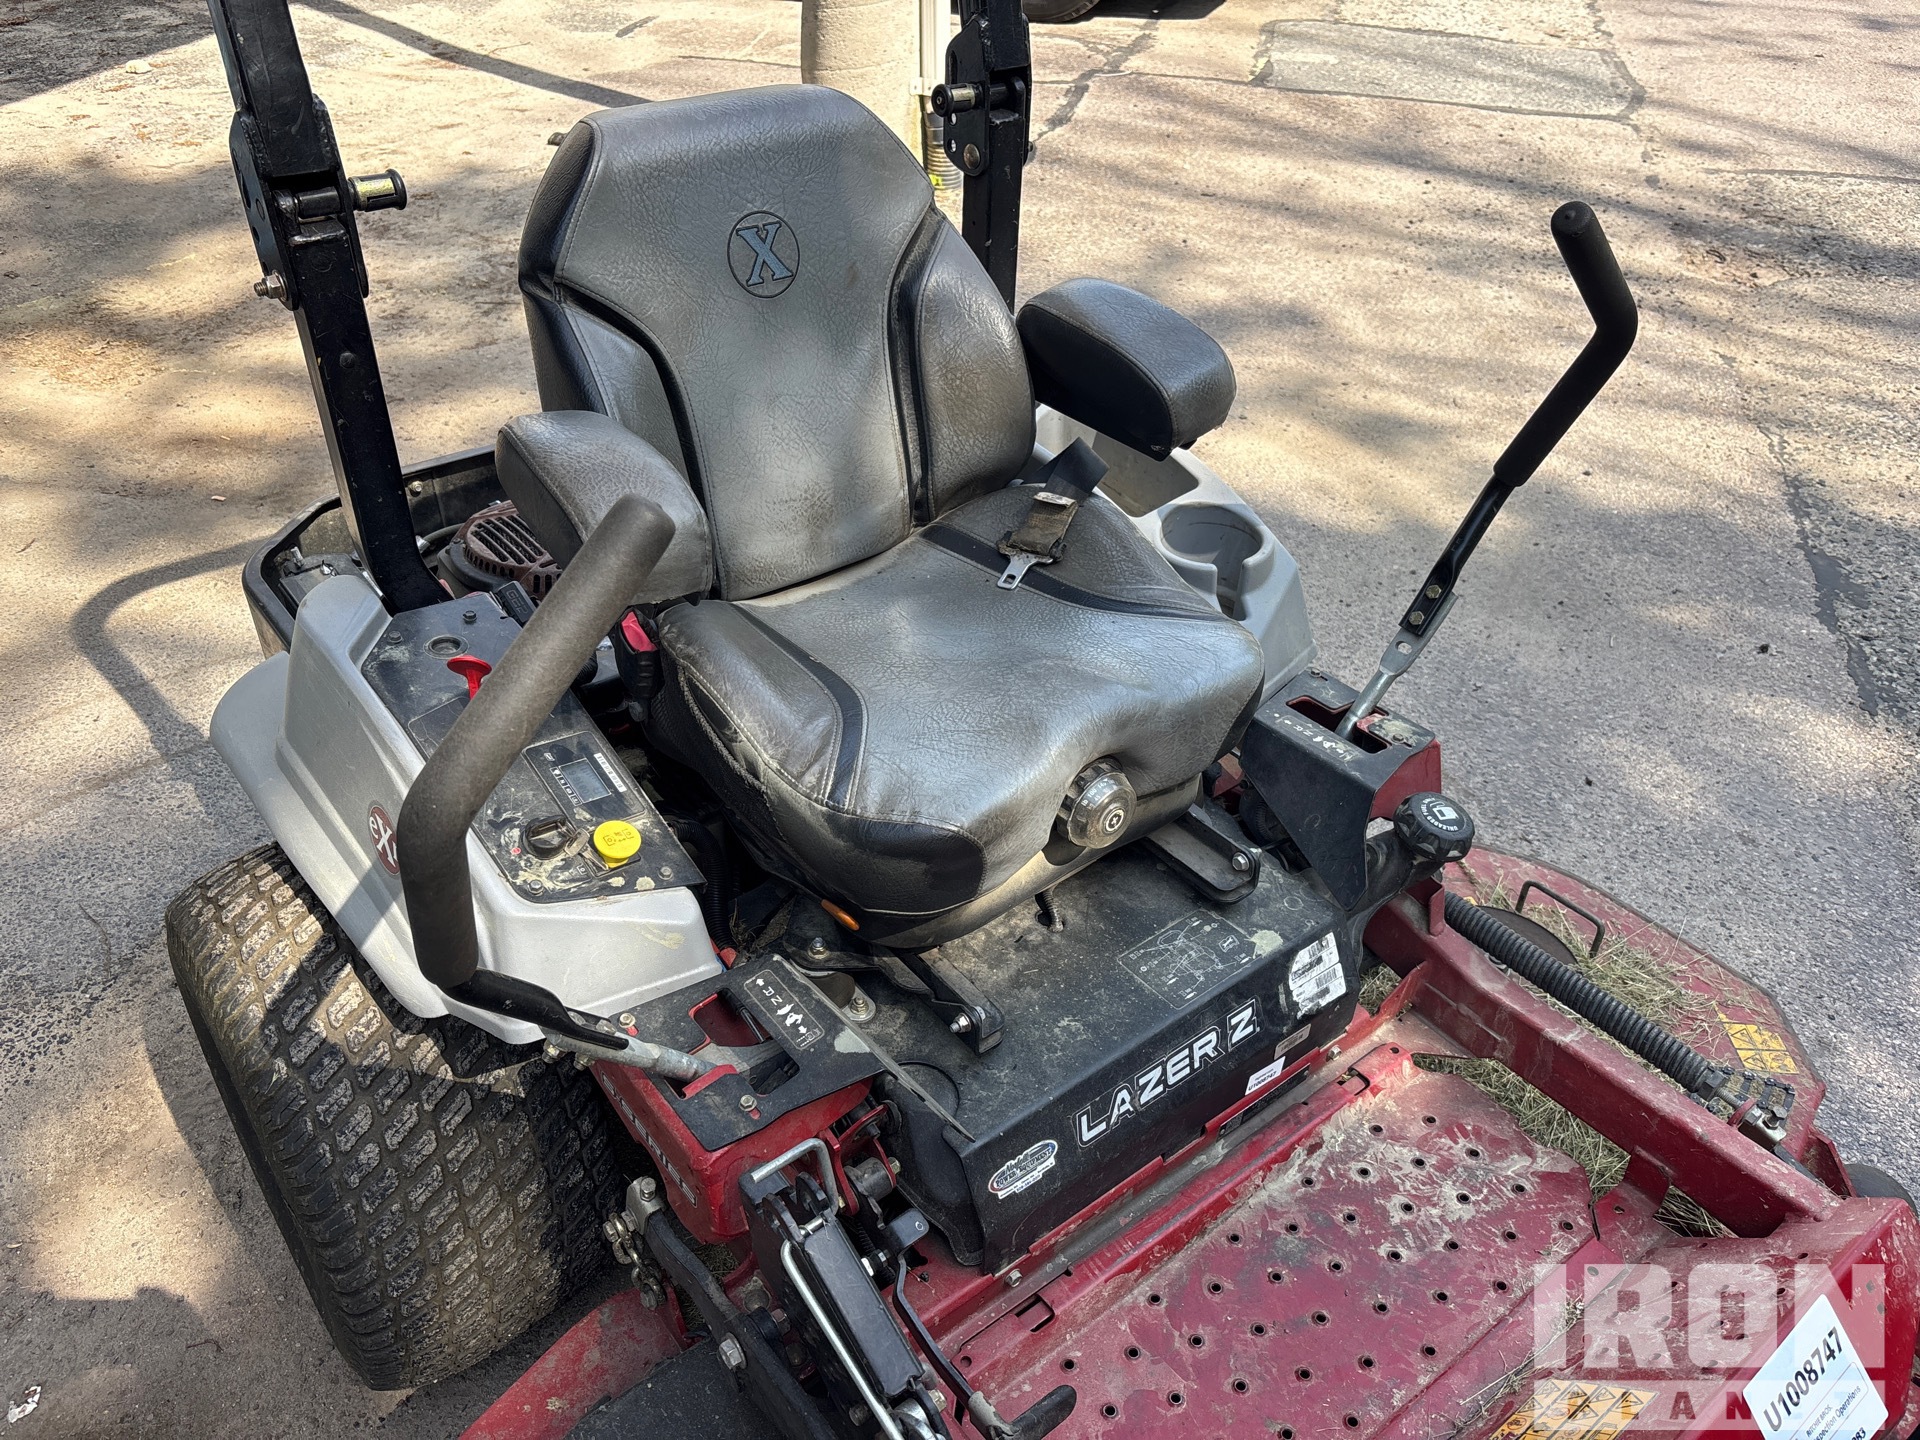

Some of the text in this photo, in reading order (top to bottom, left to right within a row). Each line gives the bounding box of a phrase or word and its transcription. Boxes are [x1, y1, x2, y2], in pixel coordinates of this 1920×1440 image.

[736, 221, 793, 287] X
[1427, 815, 1459, 832] UNLEADED
[762, 986, 775, 997] R
[770, 994, 783, 1006] N
[1080, 1029, 1222, 1143] LAZER
[1229, 1003, 1256, 1047] Z
[1763, 1327, 1843, 1432] U1008747
[1835, 1385, 1861, 1418] Operations
